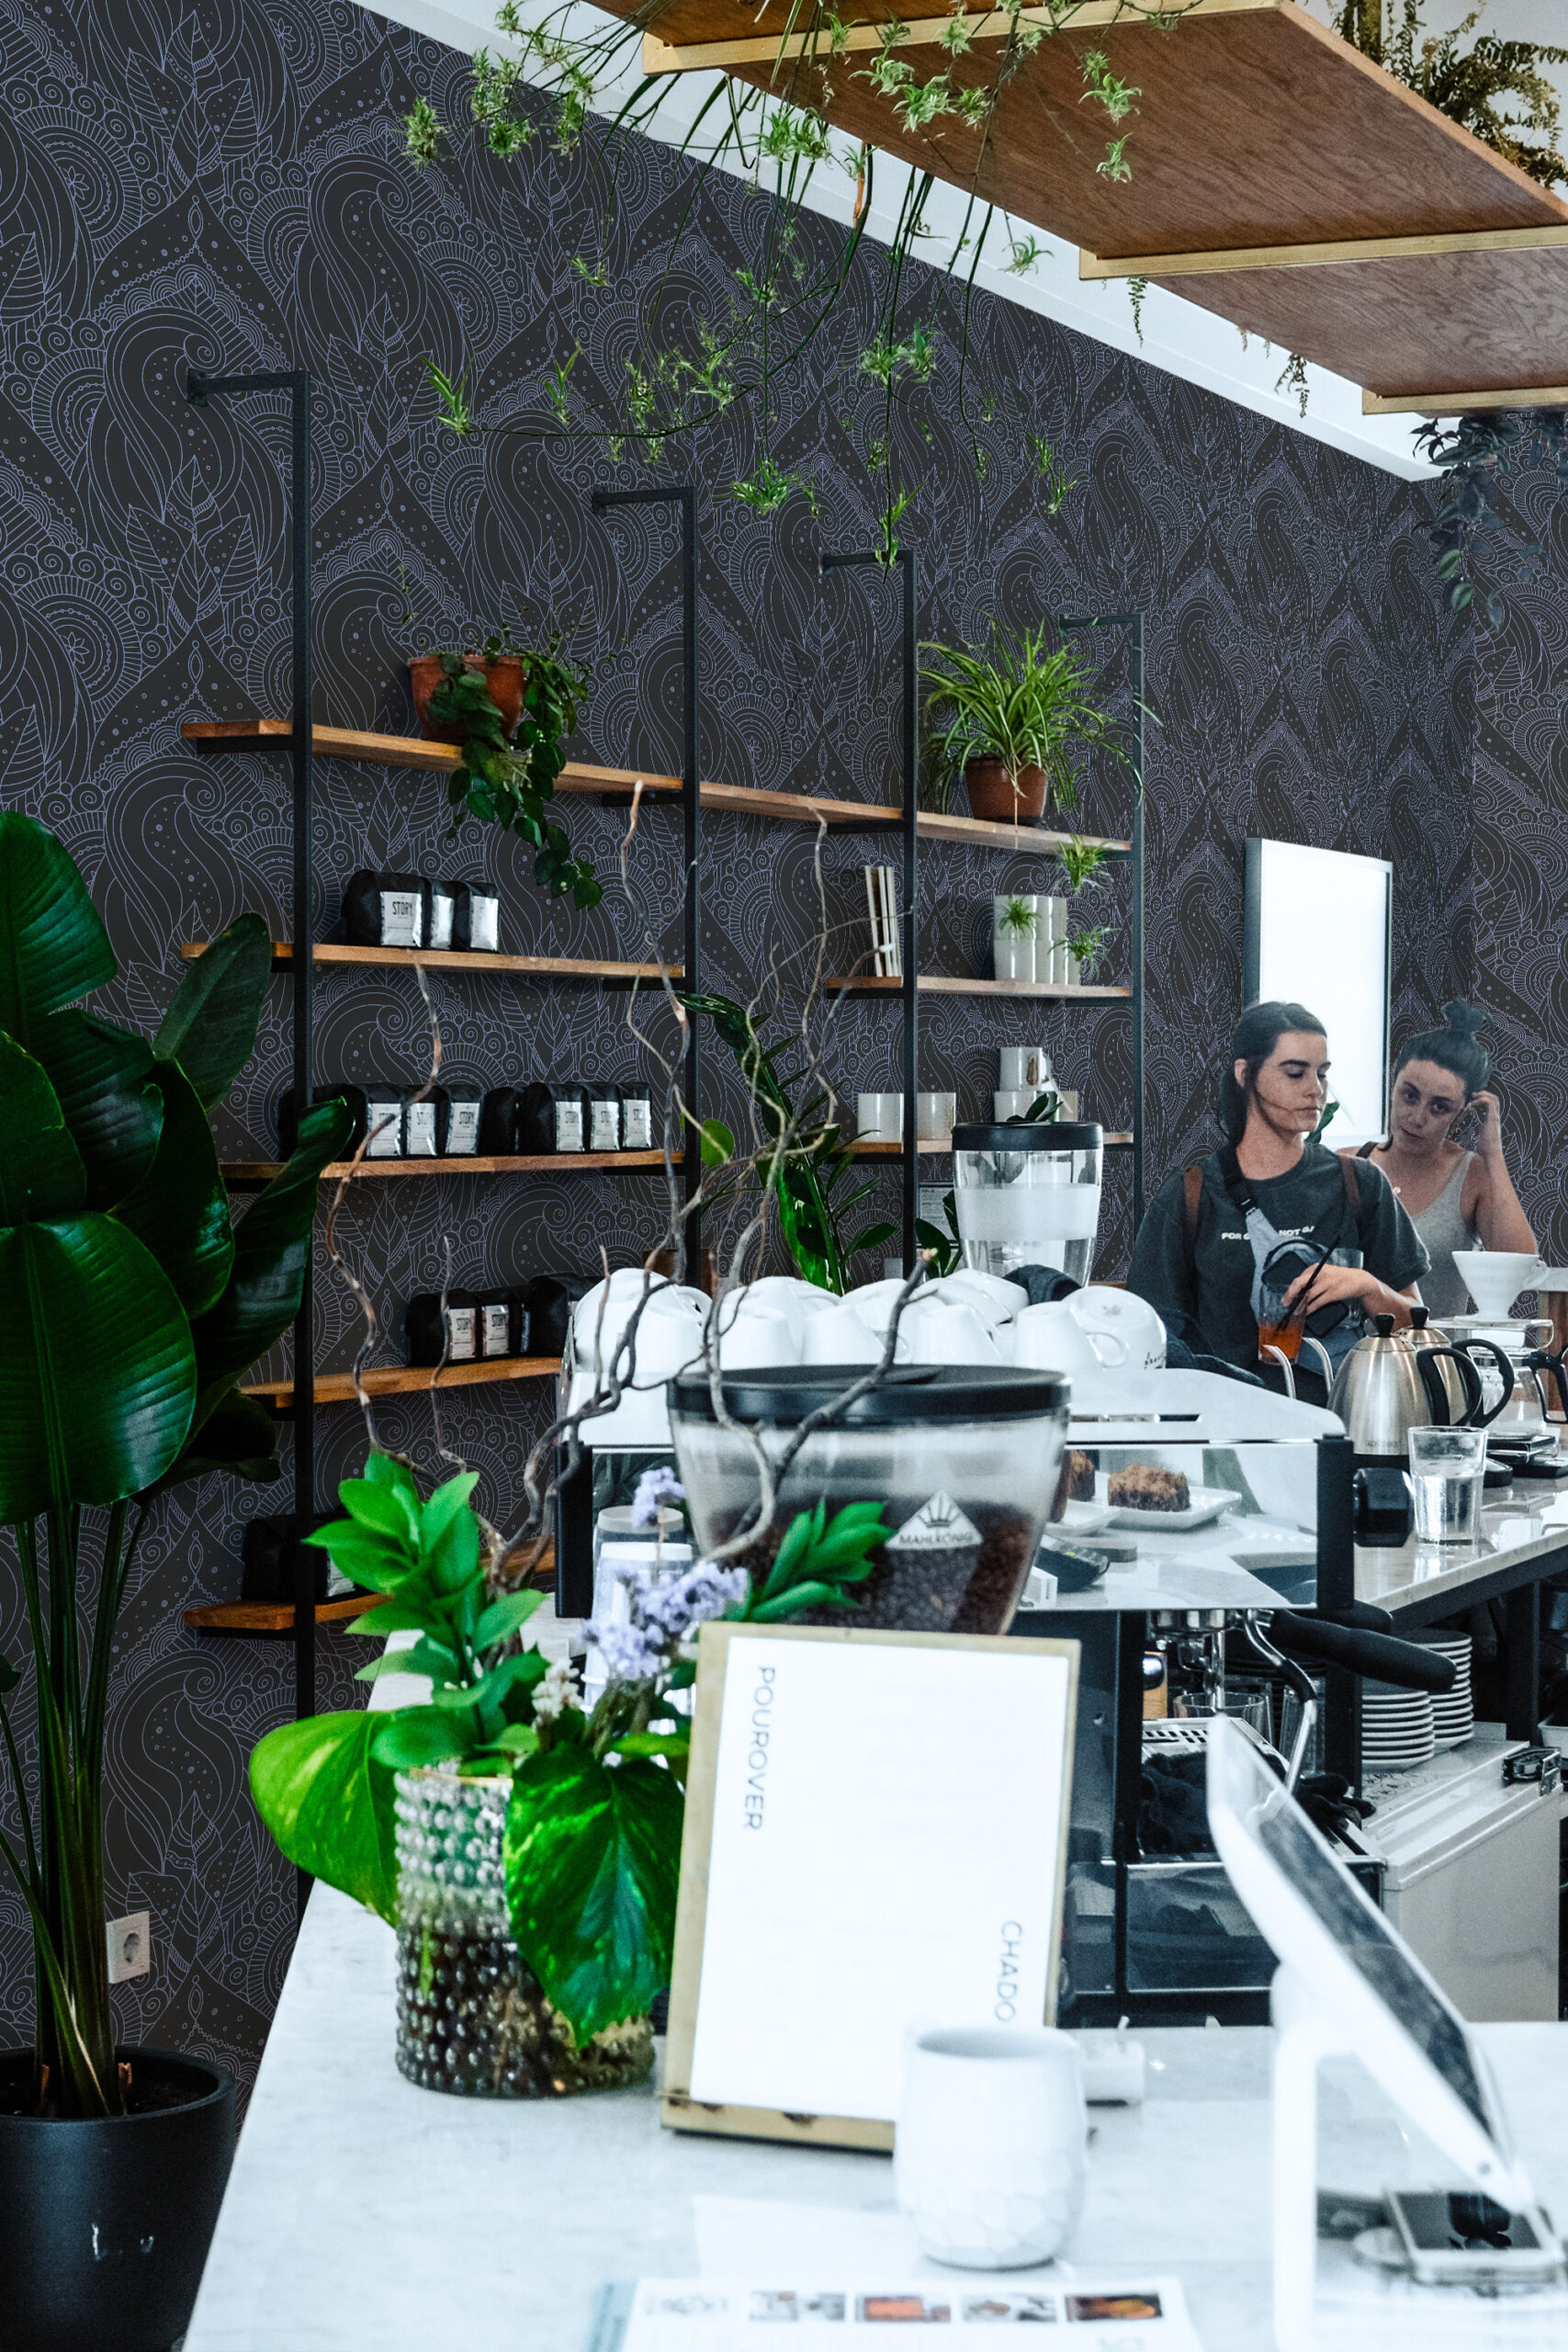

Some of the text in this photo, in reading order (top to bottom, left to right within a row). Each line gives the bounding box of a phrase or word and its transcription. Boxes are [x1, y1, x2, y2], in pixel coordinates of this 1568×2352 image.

[1221, 1232, 1242, 1240] FOR
[1279, 1228, 1301, 1237] NOT
[743, 1667, 776, 1830] POUROVER
[995, 1920, 1022, 2022] CHADO
